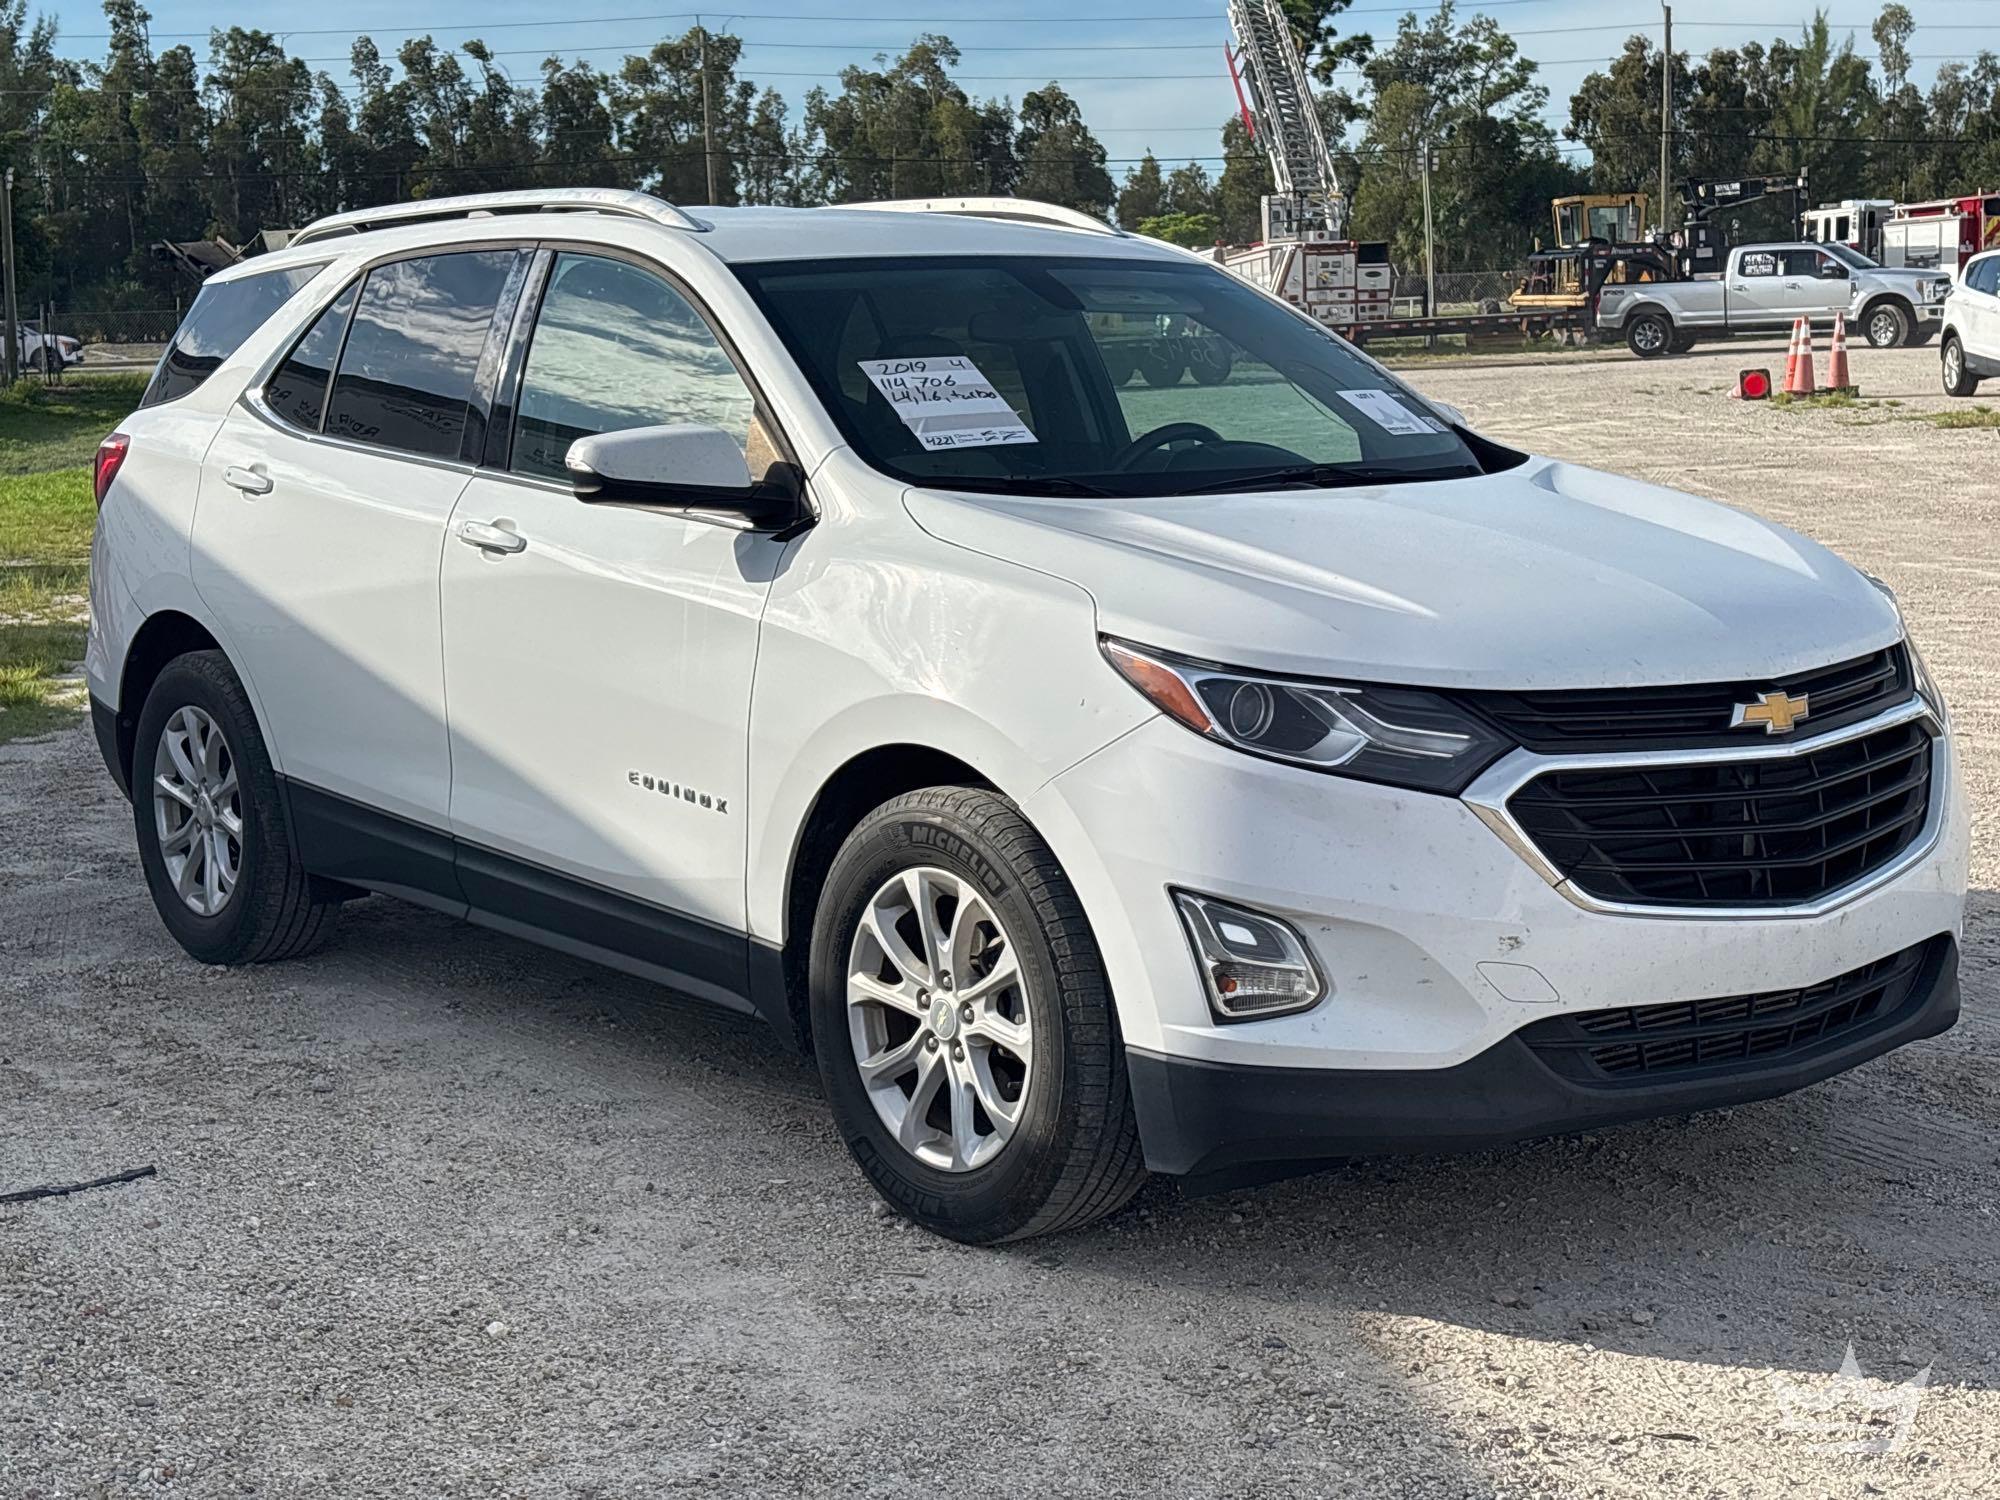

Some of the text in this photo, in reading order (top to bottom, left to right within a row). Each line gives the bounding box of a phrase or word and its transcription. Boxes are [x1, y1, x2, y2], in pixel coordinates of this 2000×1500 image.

[877, 361, 926, 375] 2019
[925, 435, 956, 446] 4221
[628, 771, 728, 815] EQUINOX
[912, 824, 1001, 892] MICHELIN
